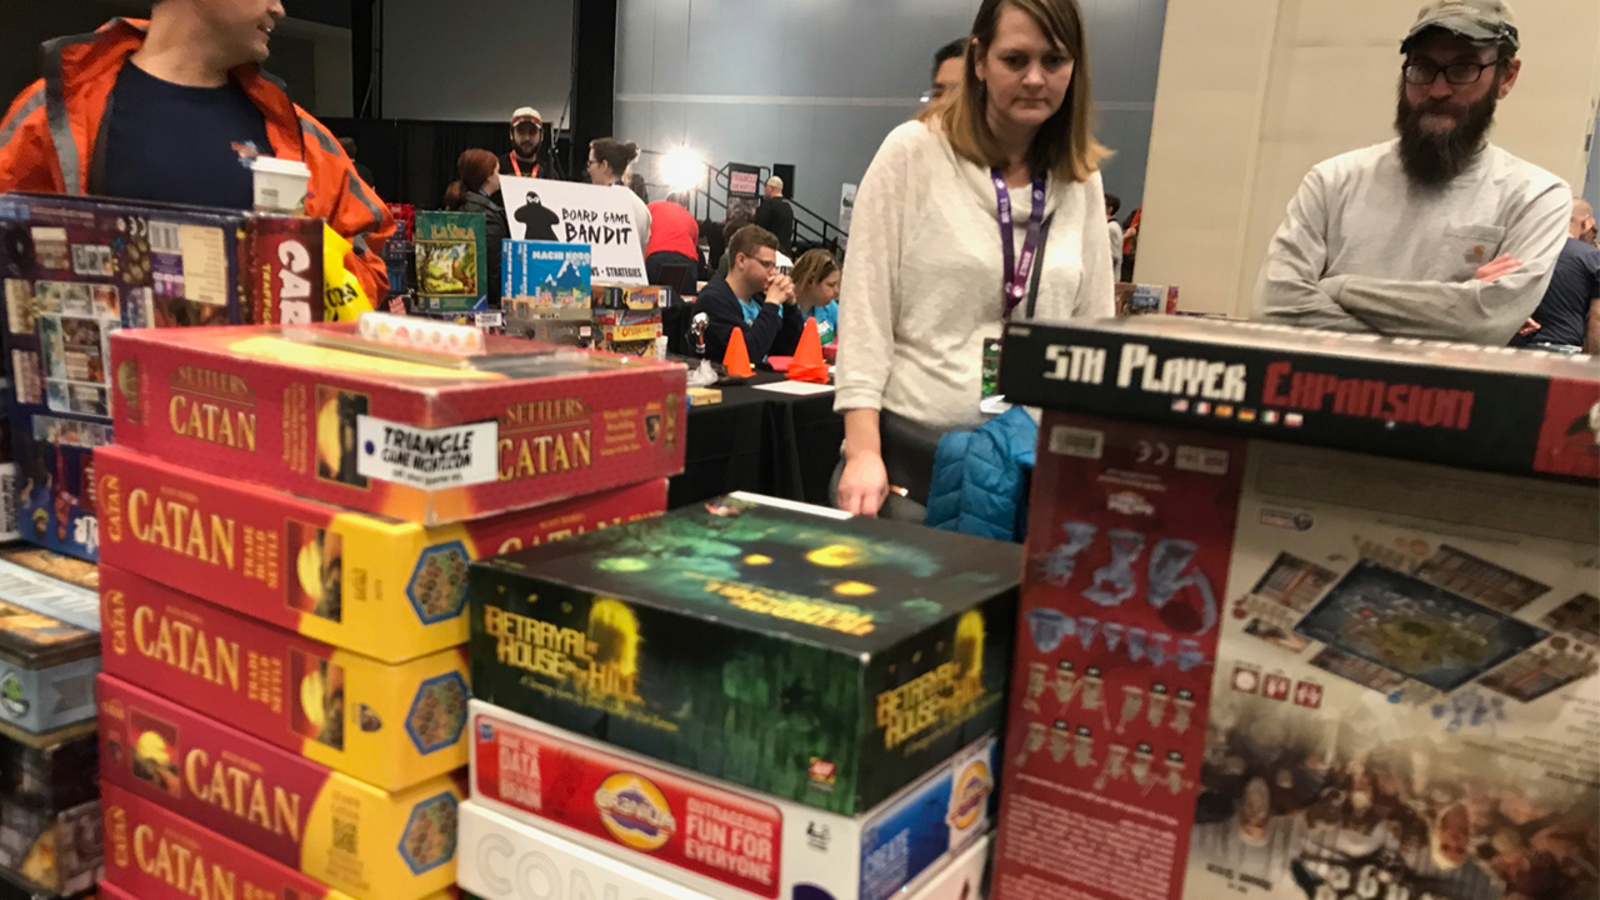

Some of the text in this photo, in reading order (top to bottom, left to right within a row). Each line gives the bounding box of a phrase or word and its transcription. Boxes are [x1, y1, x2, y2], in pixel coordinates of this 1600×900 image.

[562, 208, 631, 224] BOARD GAME
[565, 222, 632, 245] BANDIT
[605, 266, 642, 278] STRATEGIES
[1117, 343, 1246, 402] PLAYER
[1262, 361, 1475, 430] EXPANSION
[170, 395, 256, 451] CATAN
[384, 426, 474, 455] TRIANGLE
[498, 429, 591, 481] CATAN
[108, 475, 122, 542] CATAN
[128, 489, 236, 570] CATAN
[112, 591, 127, 656] CATAN
[133, 606, 240, 691] CATAN
[484, 604, 593, 660] BETRAYAL
[496, 635, 567, 681] HOUSE
[185, 748, 302, 843] CATAN
[133, 824, 236, 900] CATAN
[684, 837, 772, 886] EVERYONE
[685, 813, 772, 863] FUN FOR
